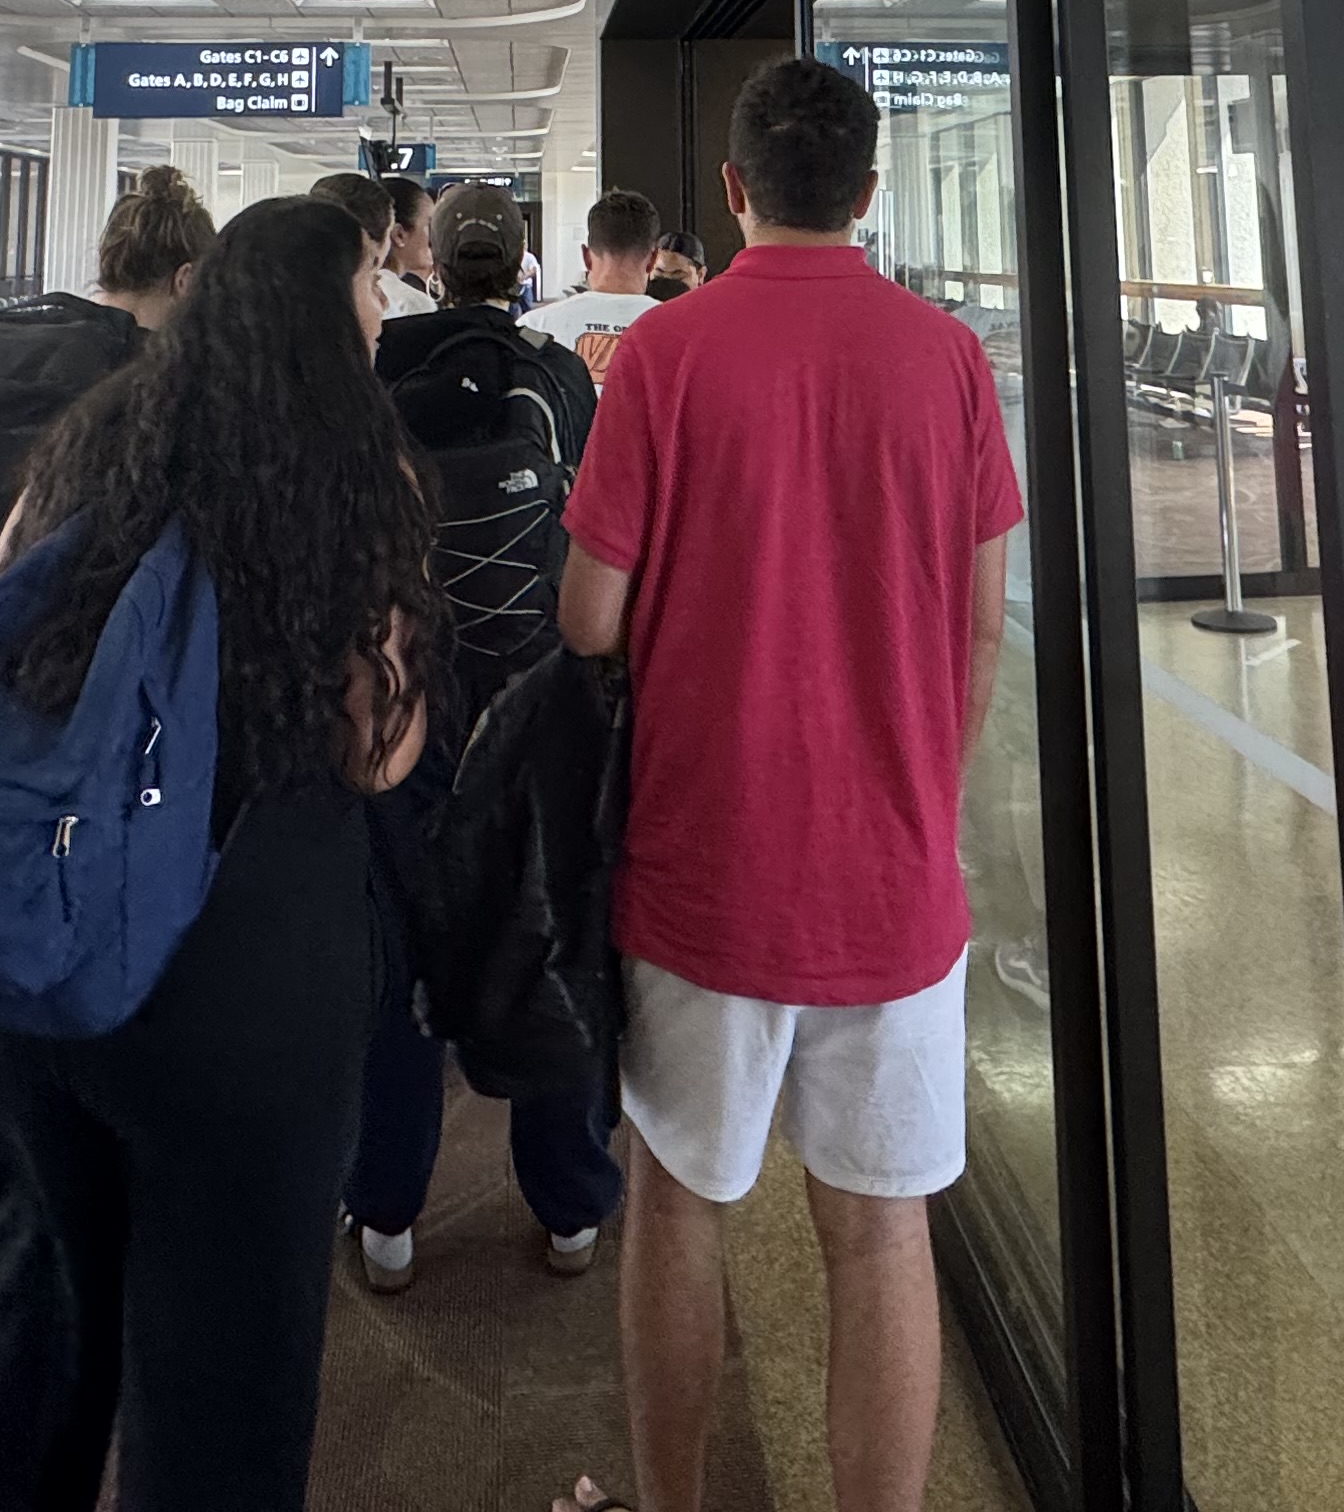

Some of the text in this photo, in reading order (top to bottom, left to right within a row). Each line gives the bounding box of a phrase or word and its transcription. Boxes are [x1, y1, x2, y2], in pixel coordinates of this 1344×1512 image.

[200, 50, 289, 64] Gates C1-C6
[128, 73, 171, 88] Gates
[277, 73, 289, 87] H
[216, 96, 288, 112] Bag Claim
[585, 323, 610, 332] THE
